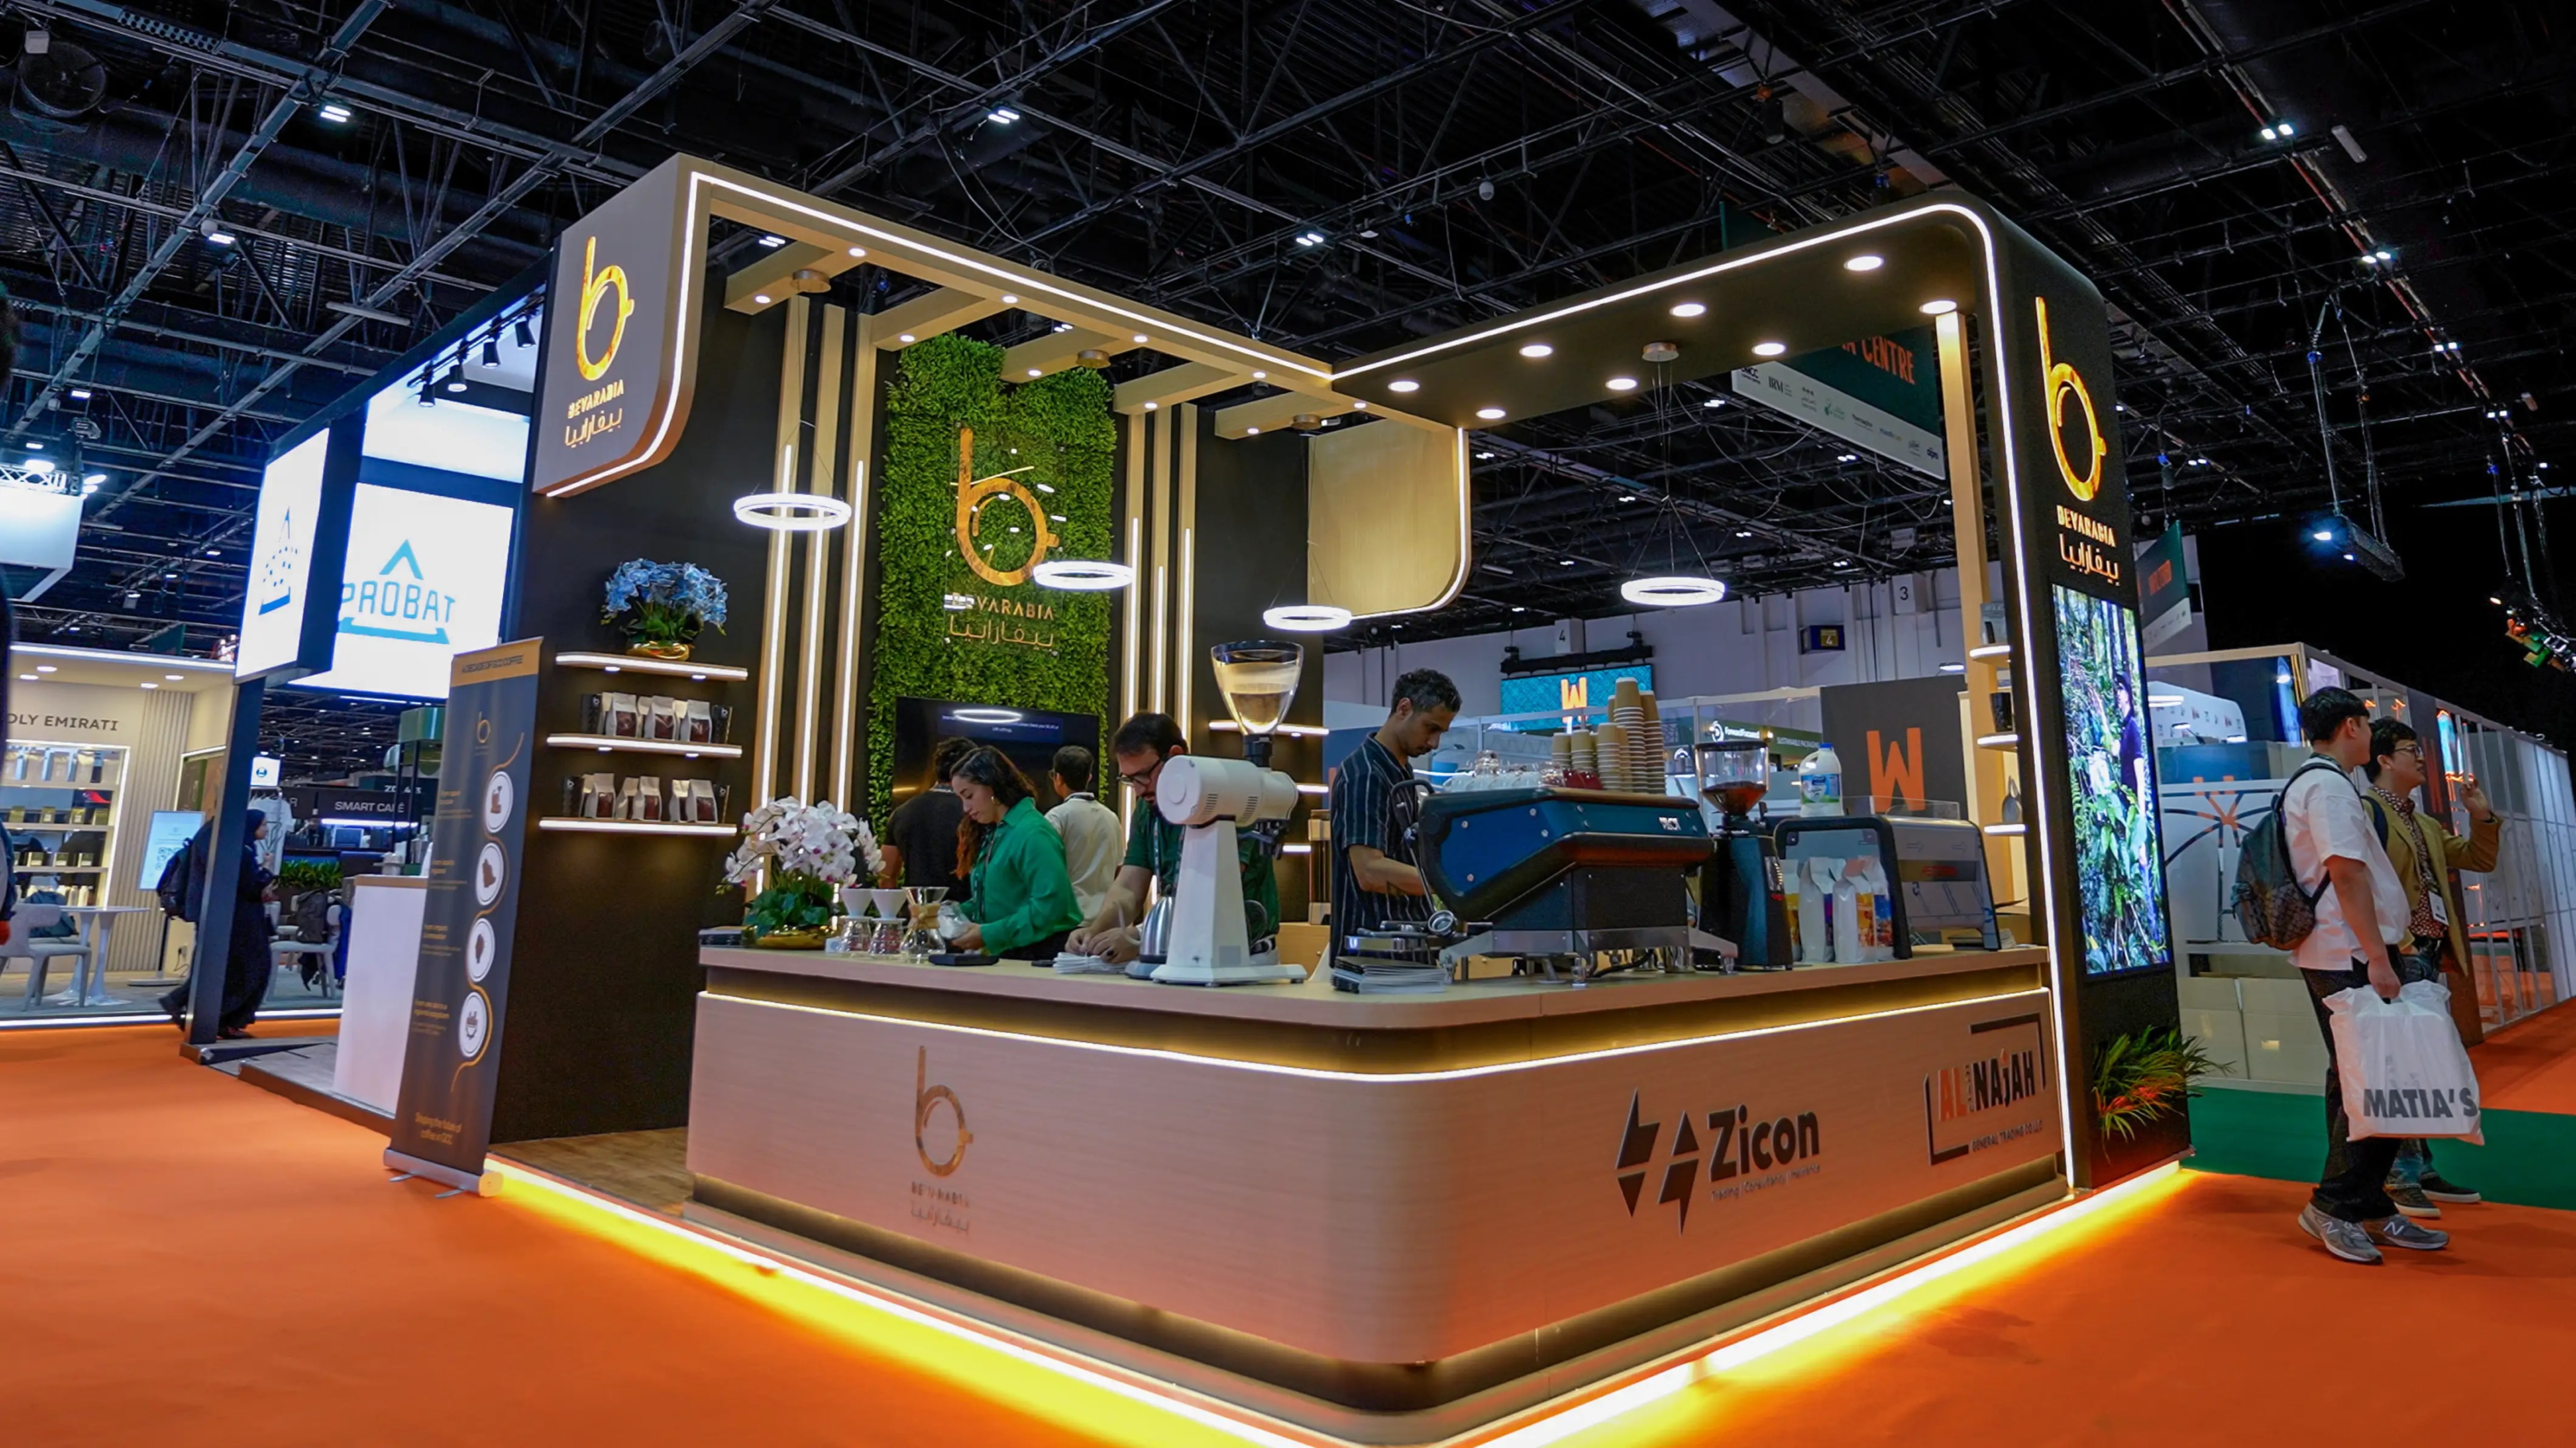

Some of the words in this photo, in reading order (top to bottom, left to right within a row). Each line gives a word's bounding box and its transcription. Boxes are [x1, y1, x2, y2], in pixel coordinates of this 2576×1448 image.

[1862, 335, 1915, 385] CENTRE
[568, 379, 624, 419] BEVARABIA
[2057, 504, 2116, 548] BEVARABIA
[341, 581, 455, 623] PROBAT
[1900, 586, 1909, 601] 3
[1559, 629, 1566, 642] 4
[1825, 635, 1833, 645] 4
[1560, 677, 1587, 710] W
[44, 715, 119, 731] EMIRATI
[1866, 727, 1925, 812] W
[335, 801, 375, 812] SMART
[2363, 1087, 2478, 1118] MATIA'S
[1707, 1104, 1820, 1182] Zicon
